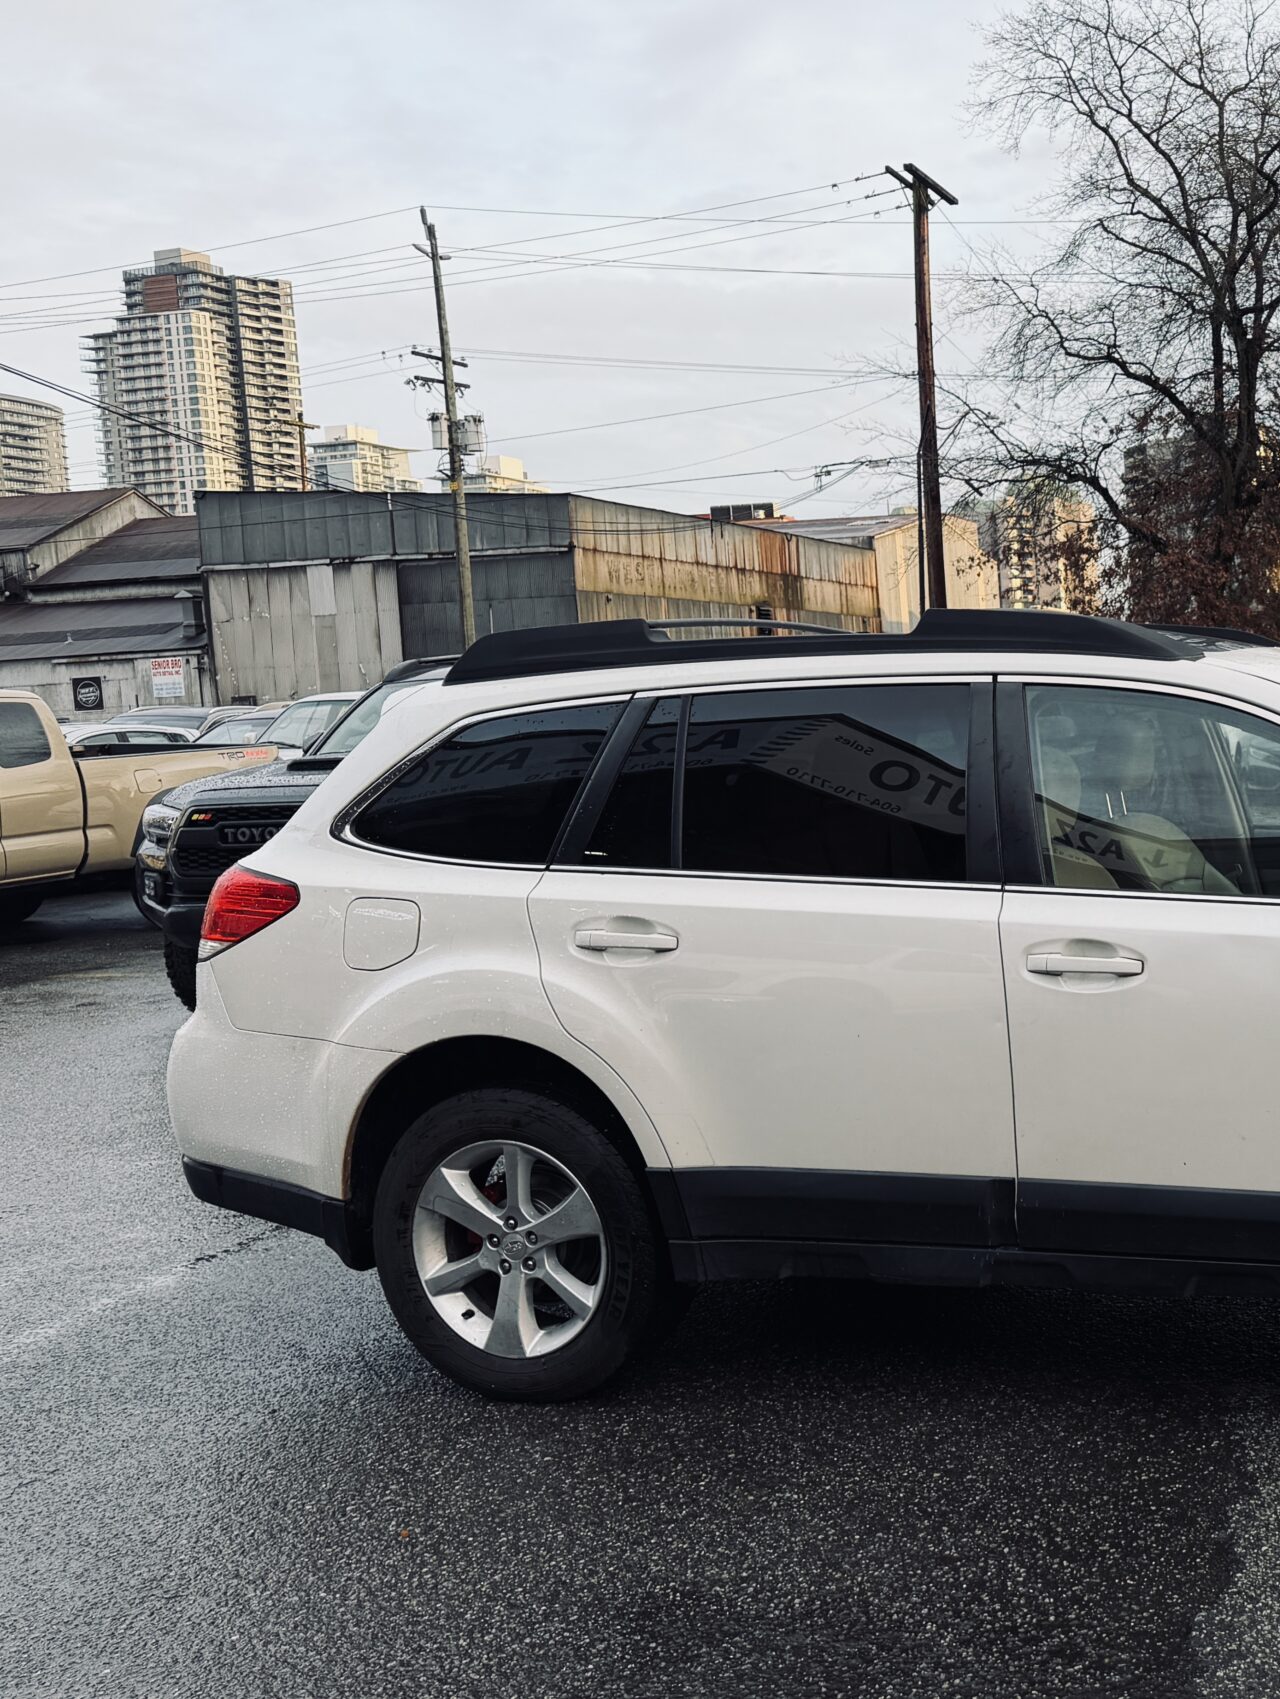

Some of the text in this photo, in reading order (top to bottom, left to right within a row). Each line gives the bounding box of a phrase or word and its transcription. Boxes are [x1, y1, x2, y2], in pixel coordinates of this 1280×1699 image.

[152, 658, 182, 670] SENIOR BRO
[224, 826, 280, 843] TOYO
